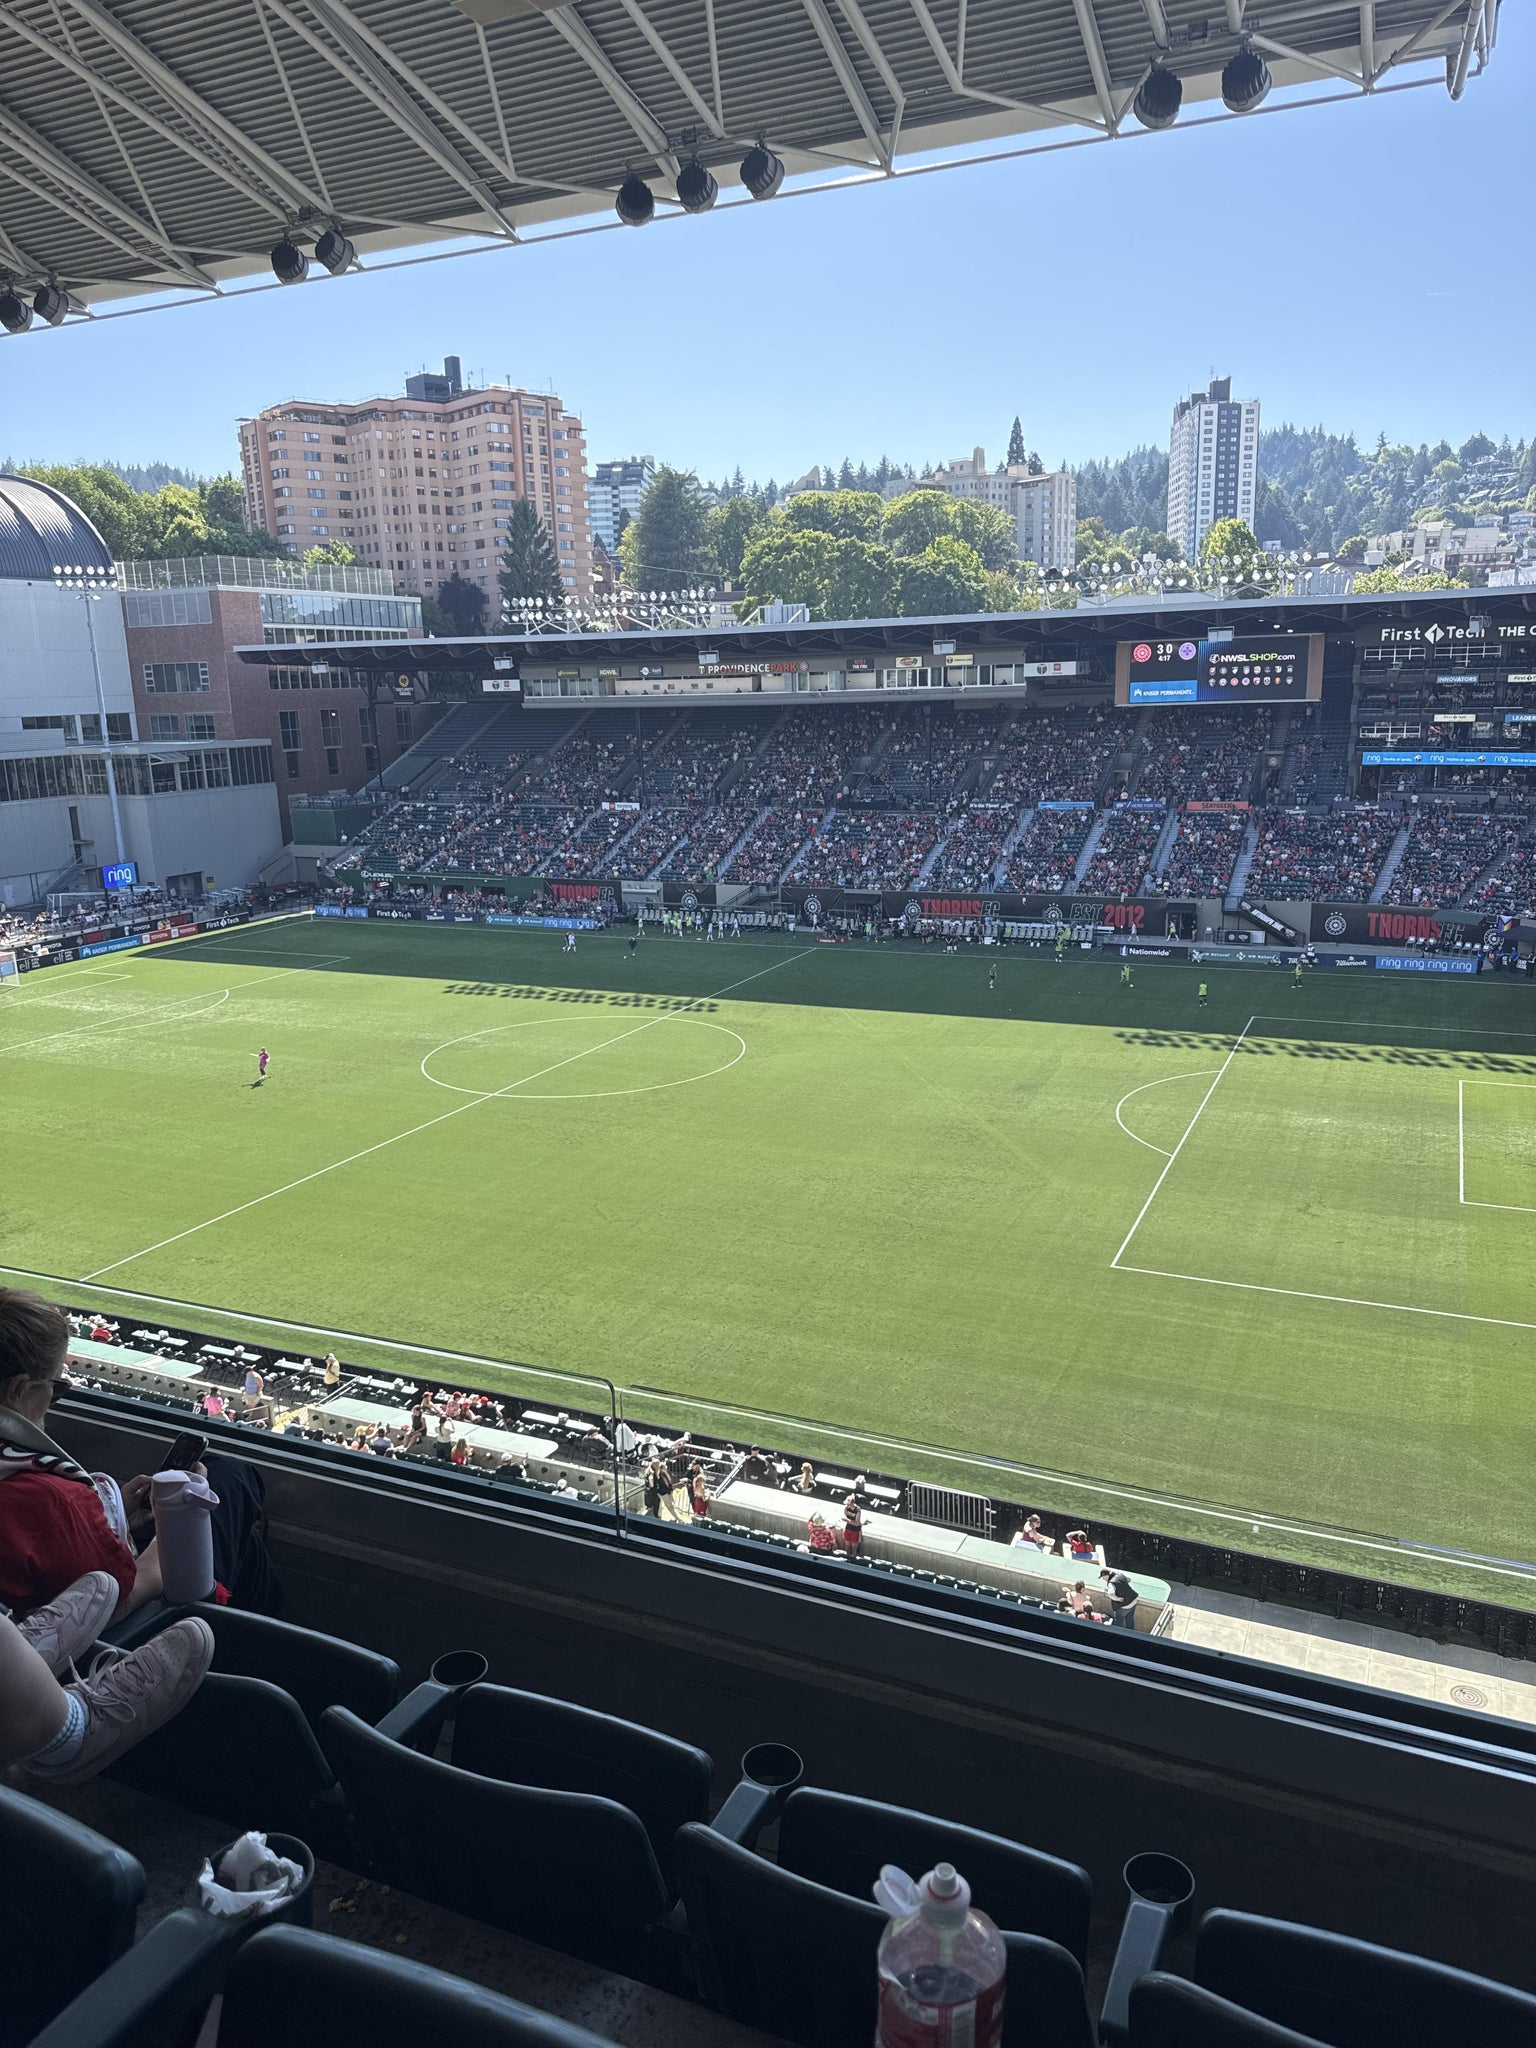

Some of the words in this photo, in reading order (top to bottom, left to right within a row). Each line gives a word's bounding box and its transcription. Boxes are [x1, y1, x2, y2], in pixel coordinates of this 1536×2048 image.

[1381, 627, 1420, 641] First
[1498, 626, 1525, 638] THE
[1157, 644, 1164, 654] 3
[1166, 643, 1172, 654] 0
[708, 662, 770, 674] PROVIDENCE
[770, 662, 796, 672] PARK
[1367, 754, 1381, 763] ring
[1430, 755, 1444, 763] ring
[1494, 755, 1508, 764] ring
[108, 868, 132, 883] ring
[552, 884, 598, 902] THORNS
[922, 898, 981, 920] THORNS
[1070, 903, 1103, 926] EST
[1104, 904, 1145, 928] 2012
[206, 921, 220, 929] First
[227, 916, 240, 924] Tech
[545, 919, 558, 928] ring
[559, 920, 572, 928] ring
[1368, 912, 1441, 940] THORNS
[151, 932, 168, 940] TOYOTA
[179, 926, 196, 934] TOYOTA
[54, 952, 65, 964] elf
[1129, 947, 1170, 957] Nationwide
[20, 959, 30, 971] elf
[1381, 959, 1401, 970] ring
[1404, 960, 1424, 970] ring
[1427, 960, 1448, 972] ring
[1451, 961, 1472, 973] ring
[192, 1406, 201, 1414] 10
